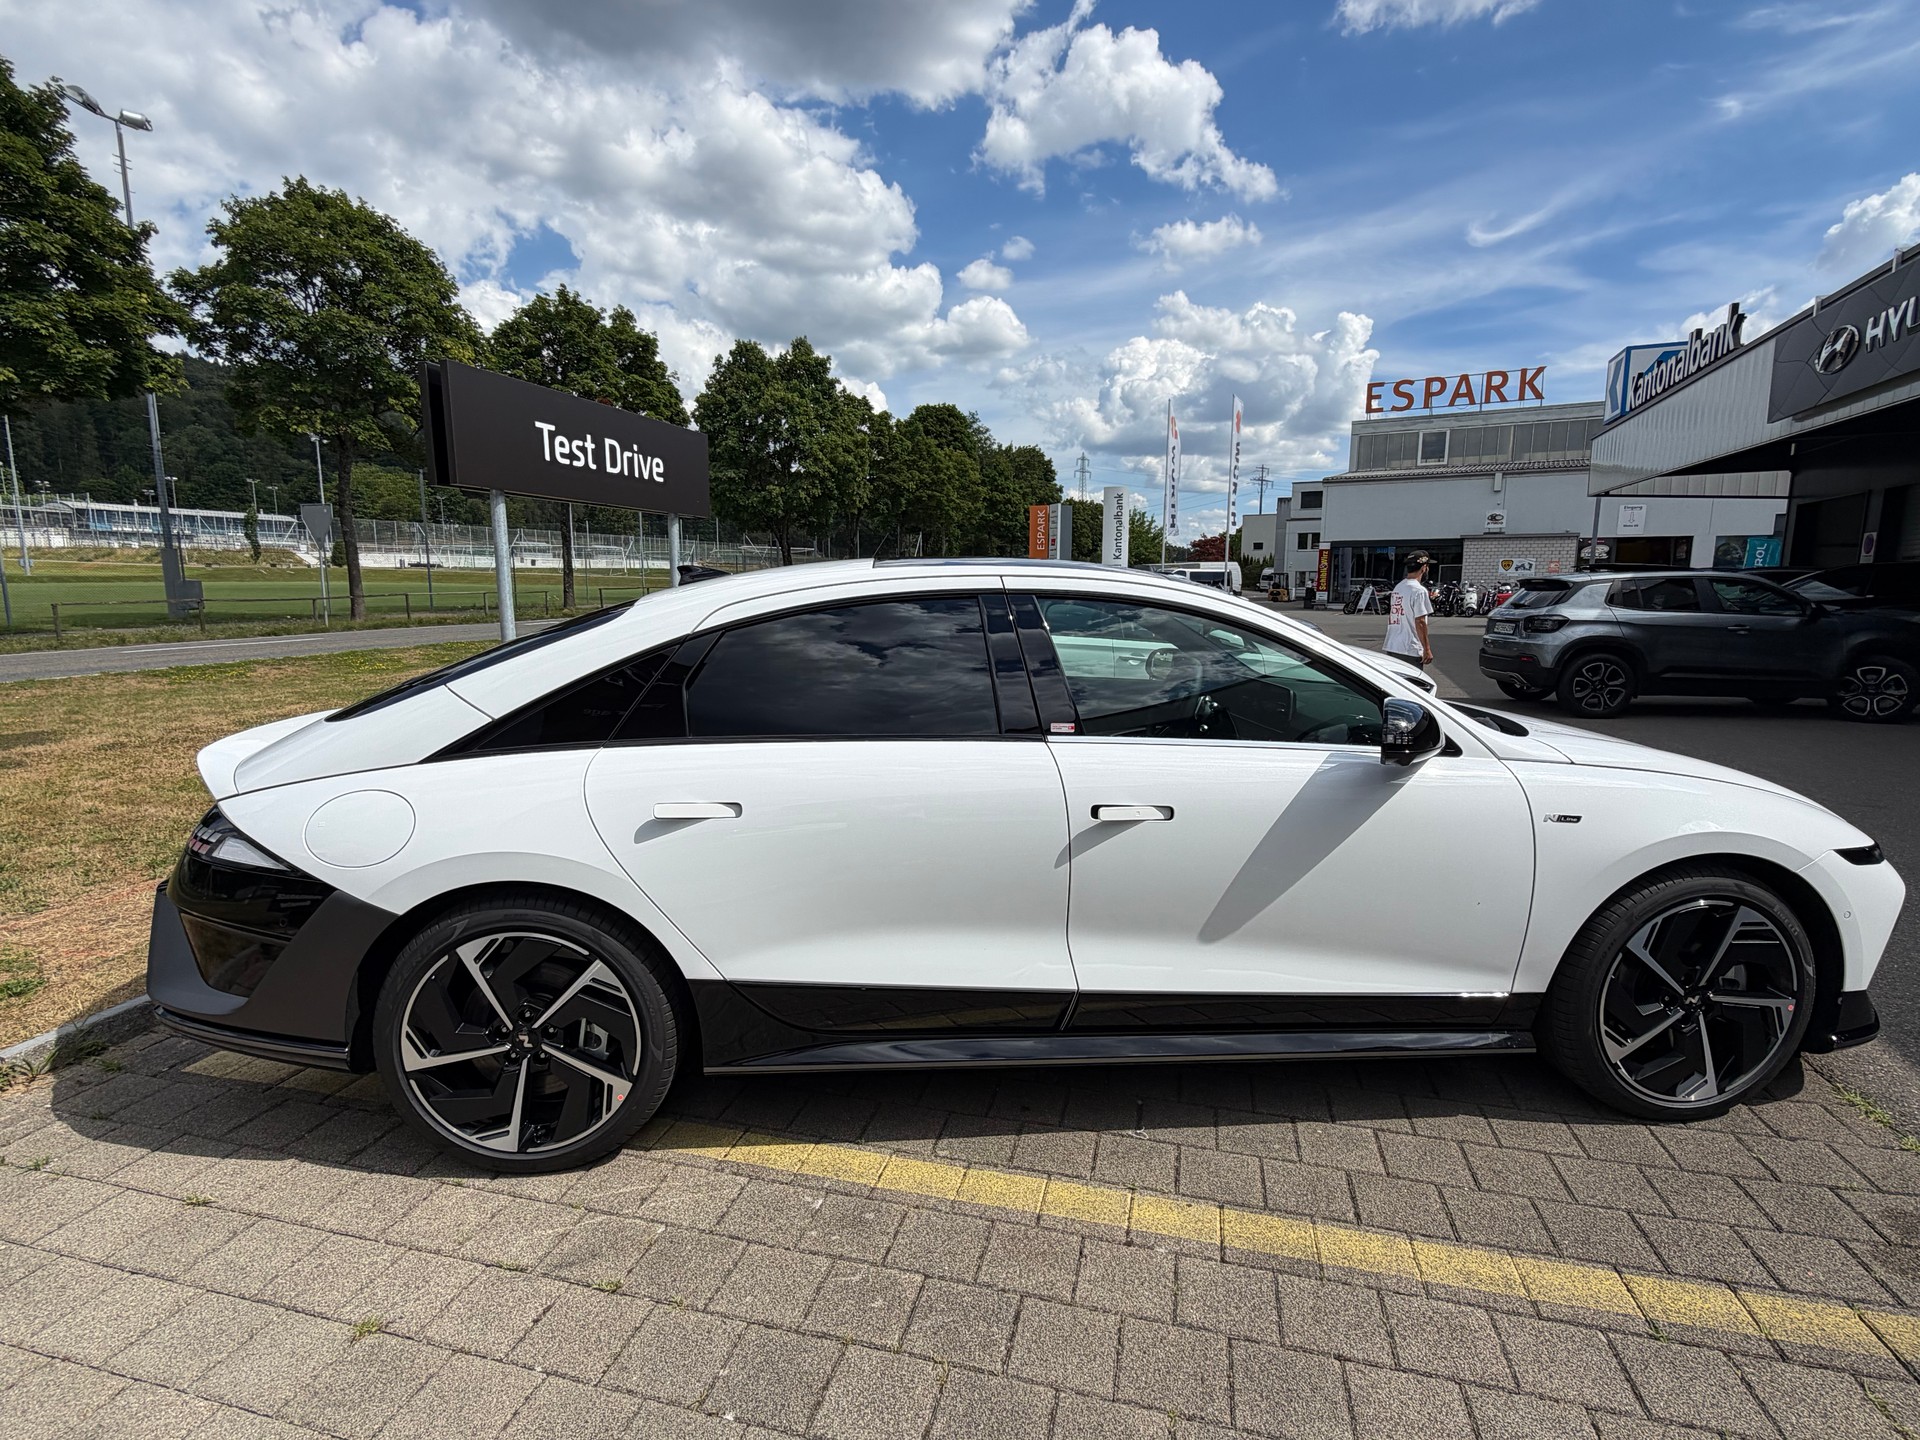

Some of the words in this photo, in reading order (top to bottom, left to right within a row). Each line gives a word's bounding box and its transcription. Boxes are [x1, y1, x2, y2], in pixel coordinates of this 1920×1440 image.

[1628, 302, 1746, 410] Kantonalbank
[1366, 366, 1547, 413] ESPARK
[534, 421, 597, 470] Test
[604, 437, 664, 483] Drive
[1037, 509, 1046, 550] ESPARK
[1113, 492, 1124, 560] Kantonalbank
[1754, 543, 1767, 566] ROL
